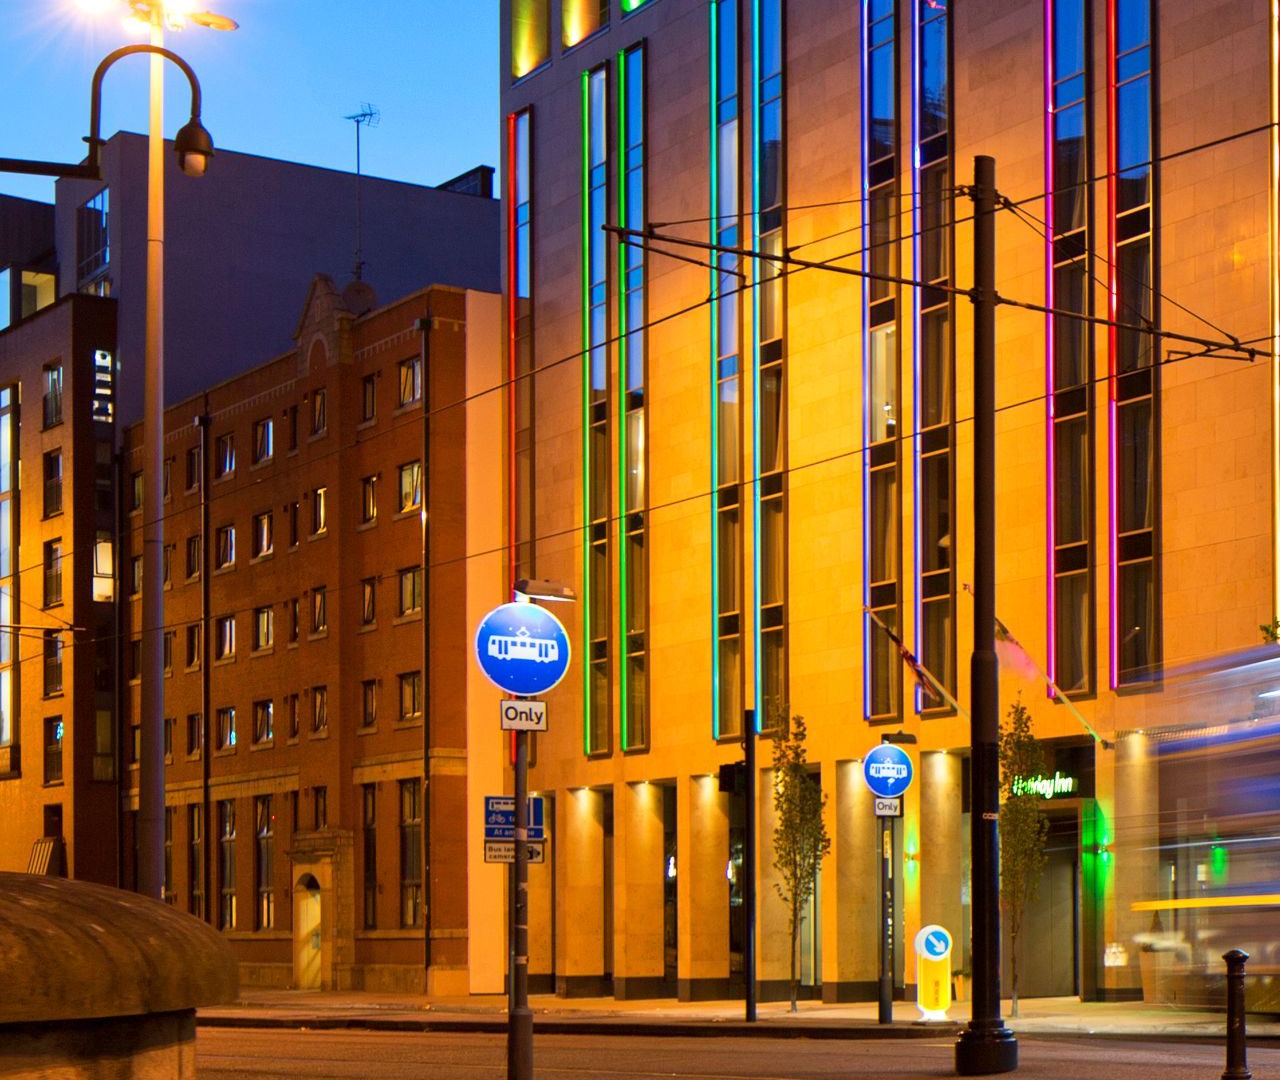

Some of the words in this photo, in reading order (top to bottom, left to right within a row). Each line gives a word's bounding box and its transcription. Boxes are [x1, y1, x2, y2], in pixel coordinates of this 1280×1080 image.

[504, 706, 544, 725] Only
[1055, 771, 1073, 793] Inn
[876, 802, 899, 813] Only
